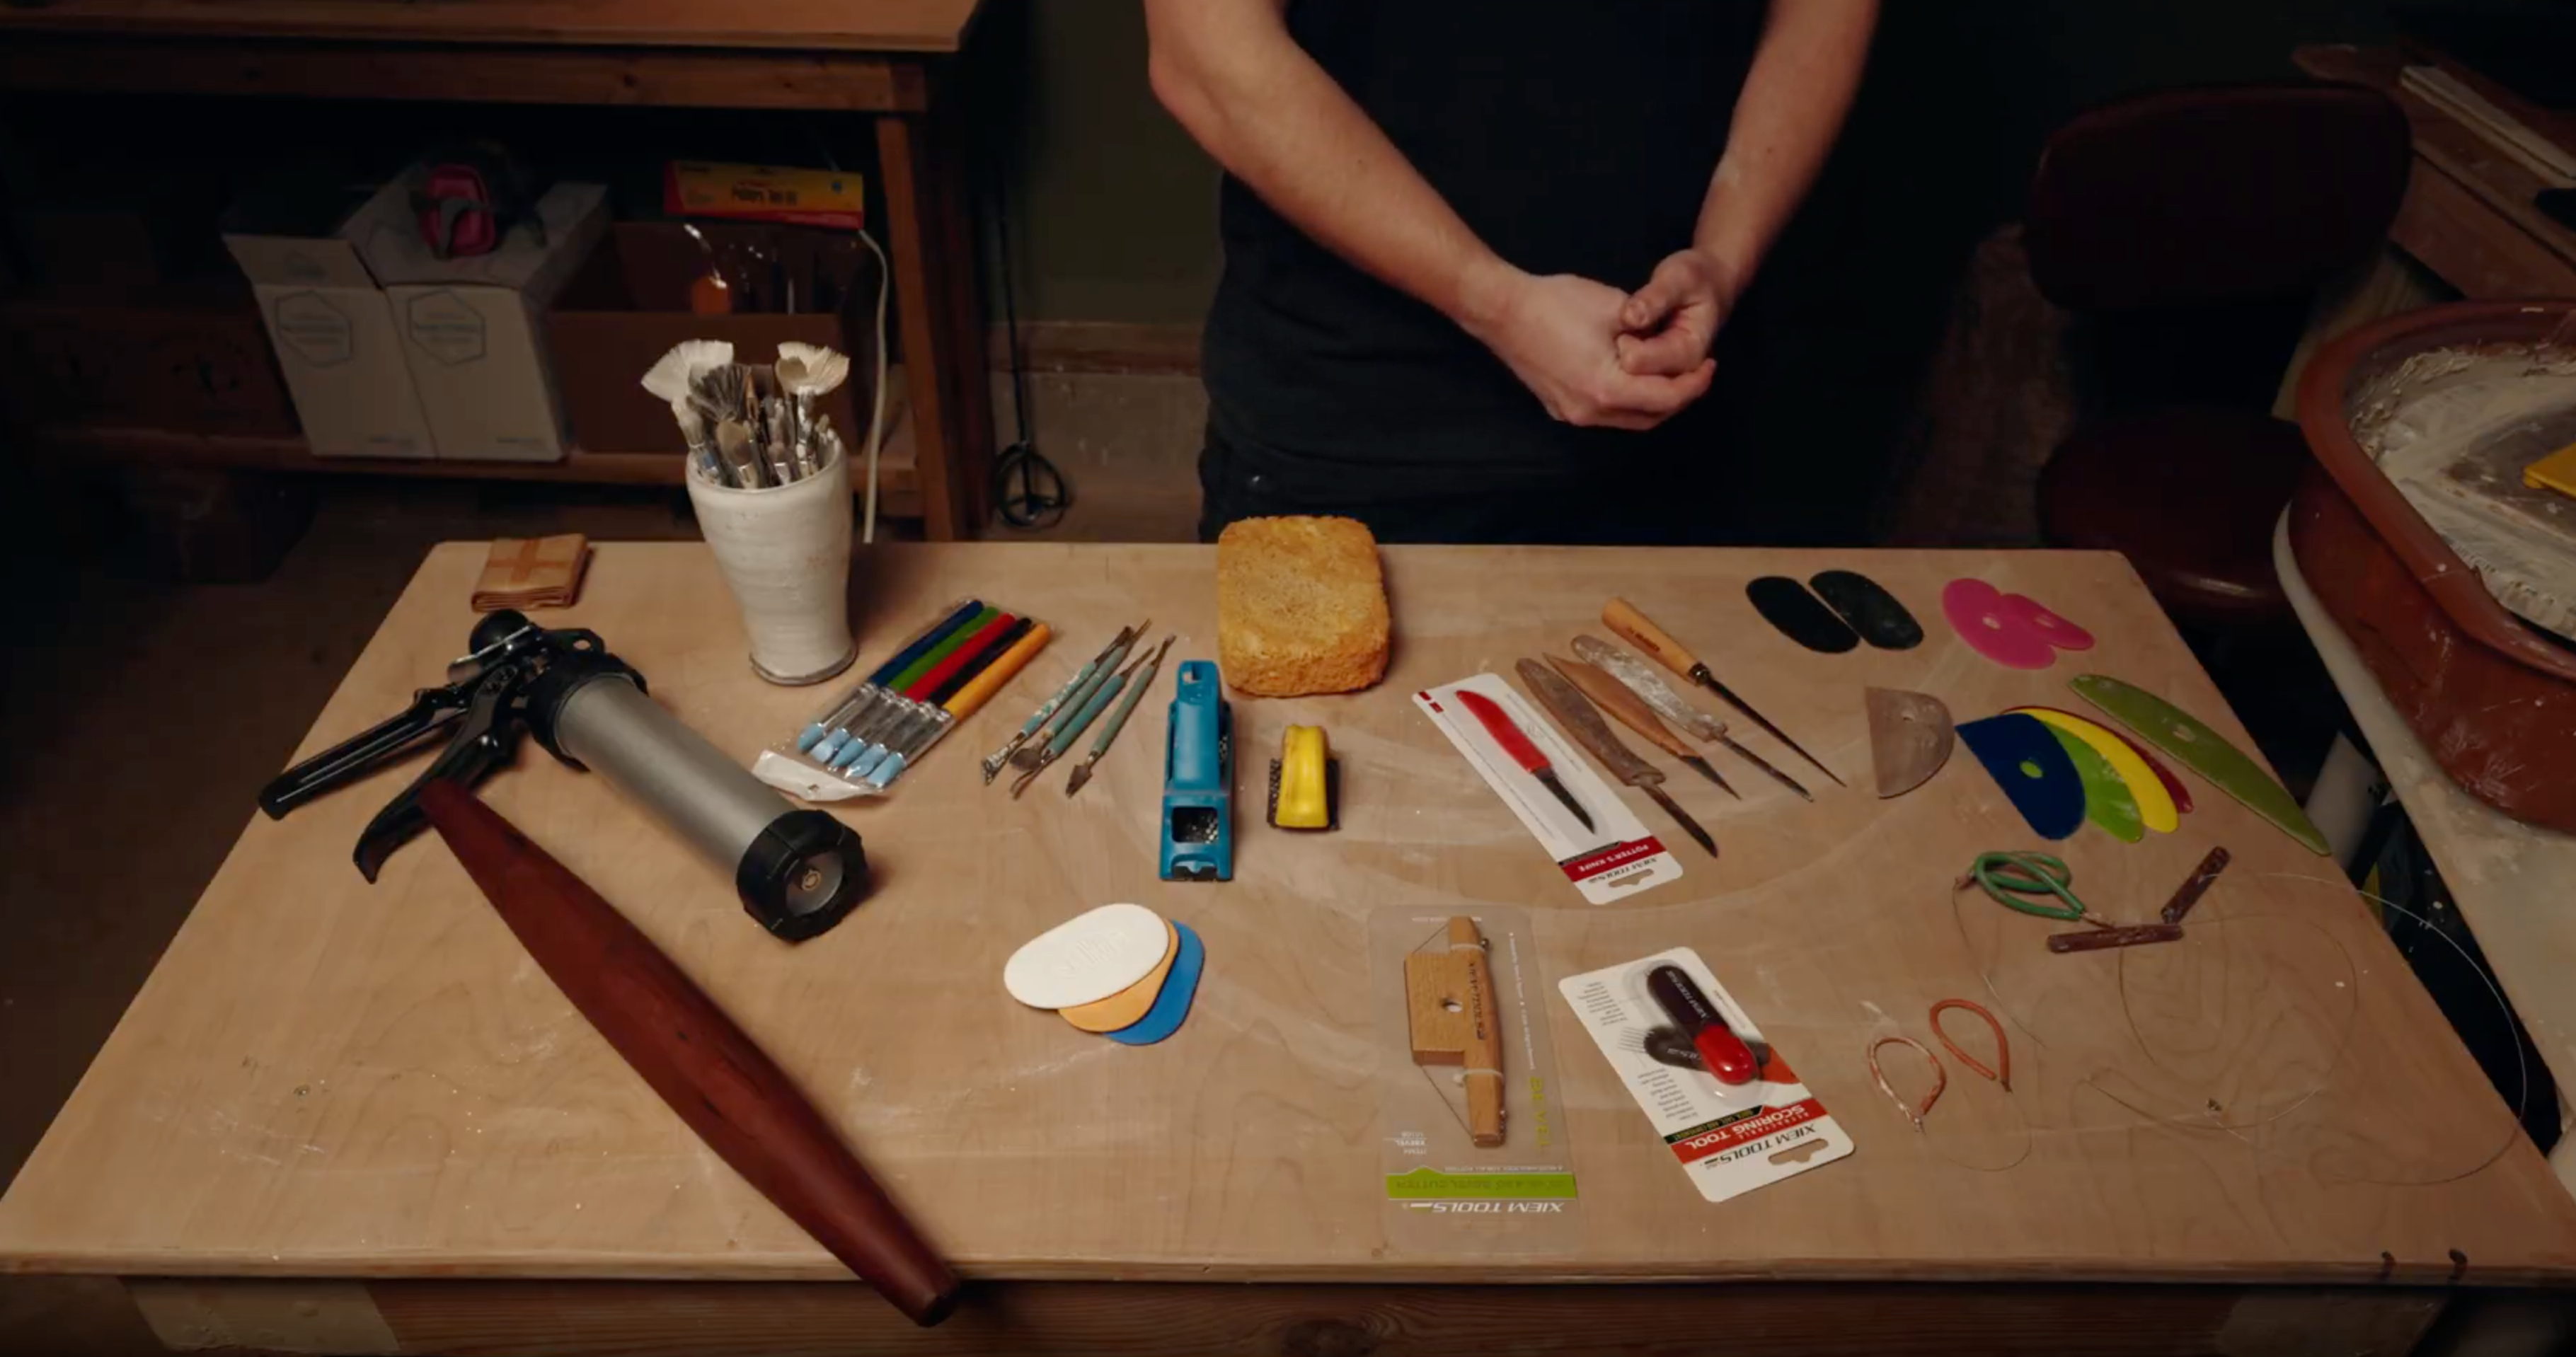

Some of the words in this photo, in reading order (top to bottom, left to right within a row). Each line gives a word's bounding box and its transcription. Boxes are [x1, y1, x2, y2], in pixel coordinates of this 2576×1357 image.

[1606, 845, 1650, 863] POTTER'S
[1577, 859, 1606, 872] KNIFE
[1731, 1104, 1805, 1134] SCORING
[1684, 1130, 1731, 1150] TOOL
[1775, 1124, 1817, 1144] XIEM
[1720, 1138, 1773, 1162] TOOLS
[1432, 1201, 1502, 1213] TOOLS
[1507, 1201, 1564, 1213] XIEM
